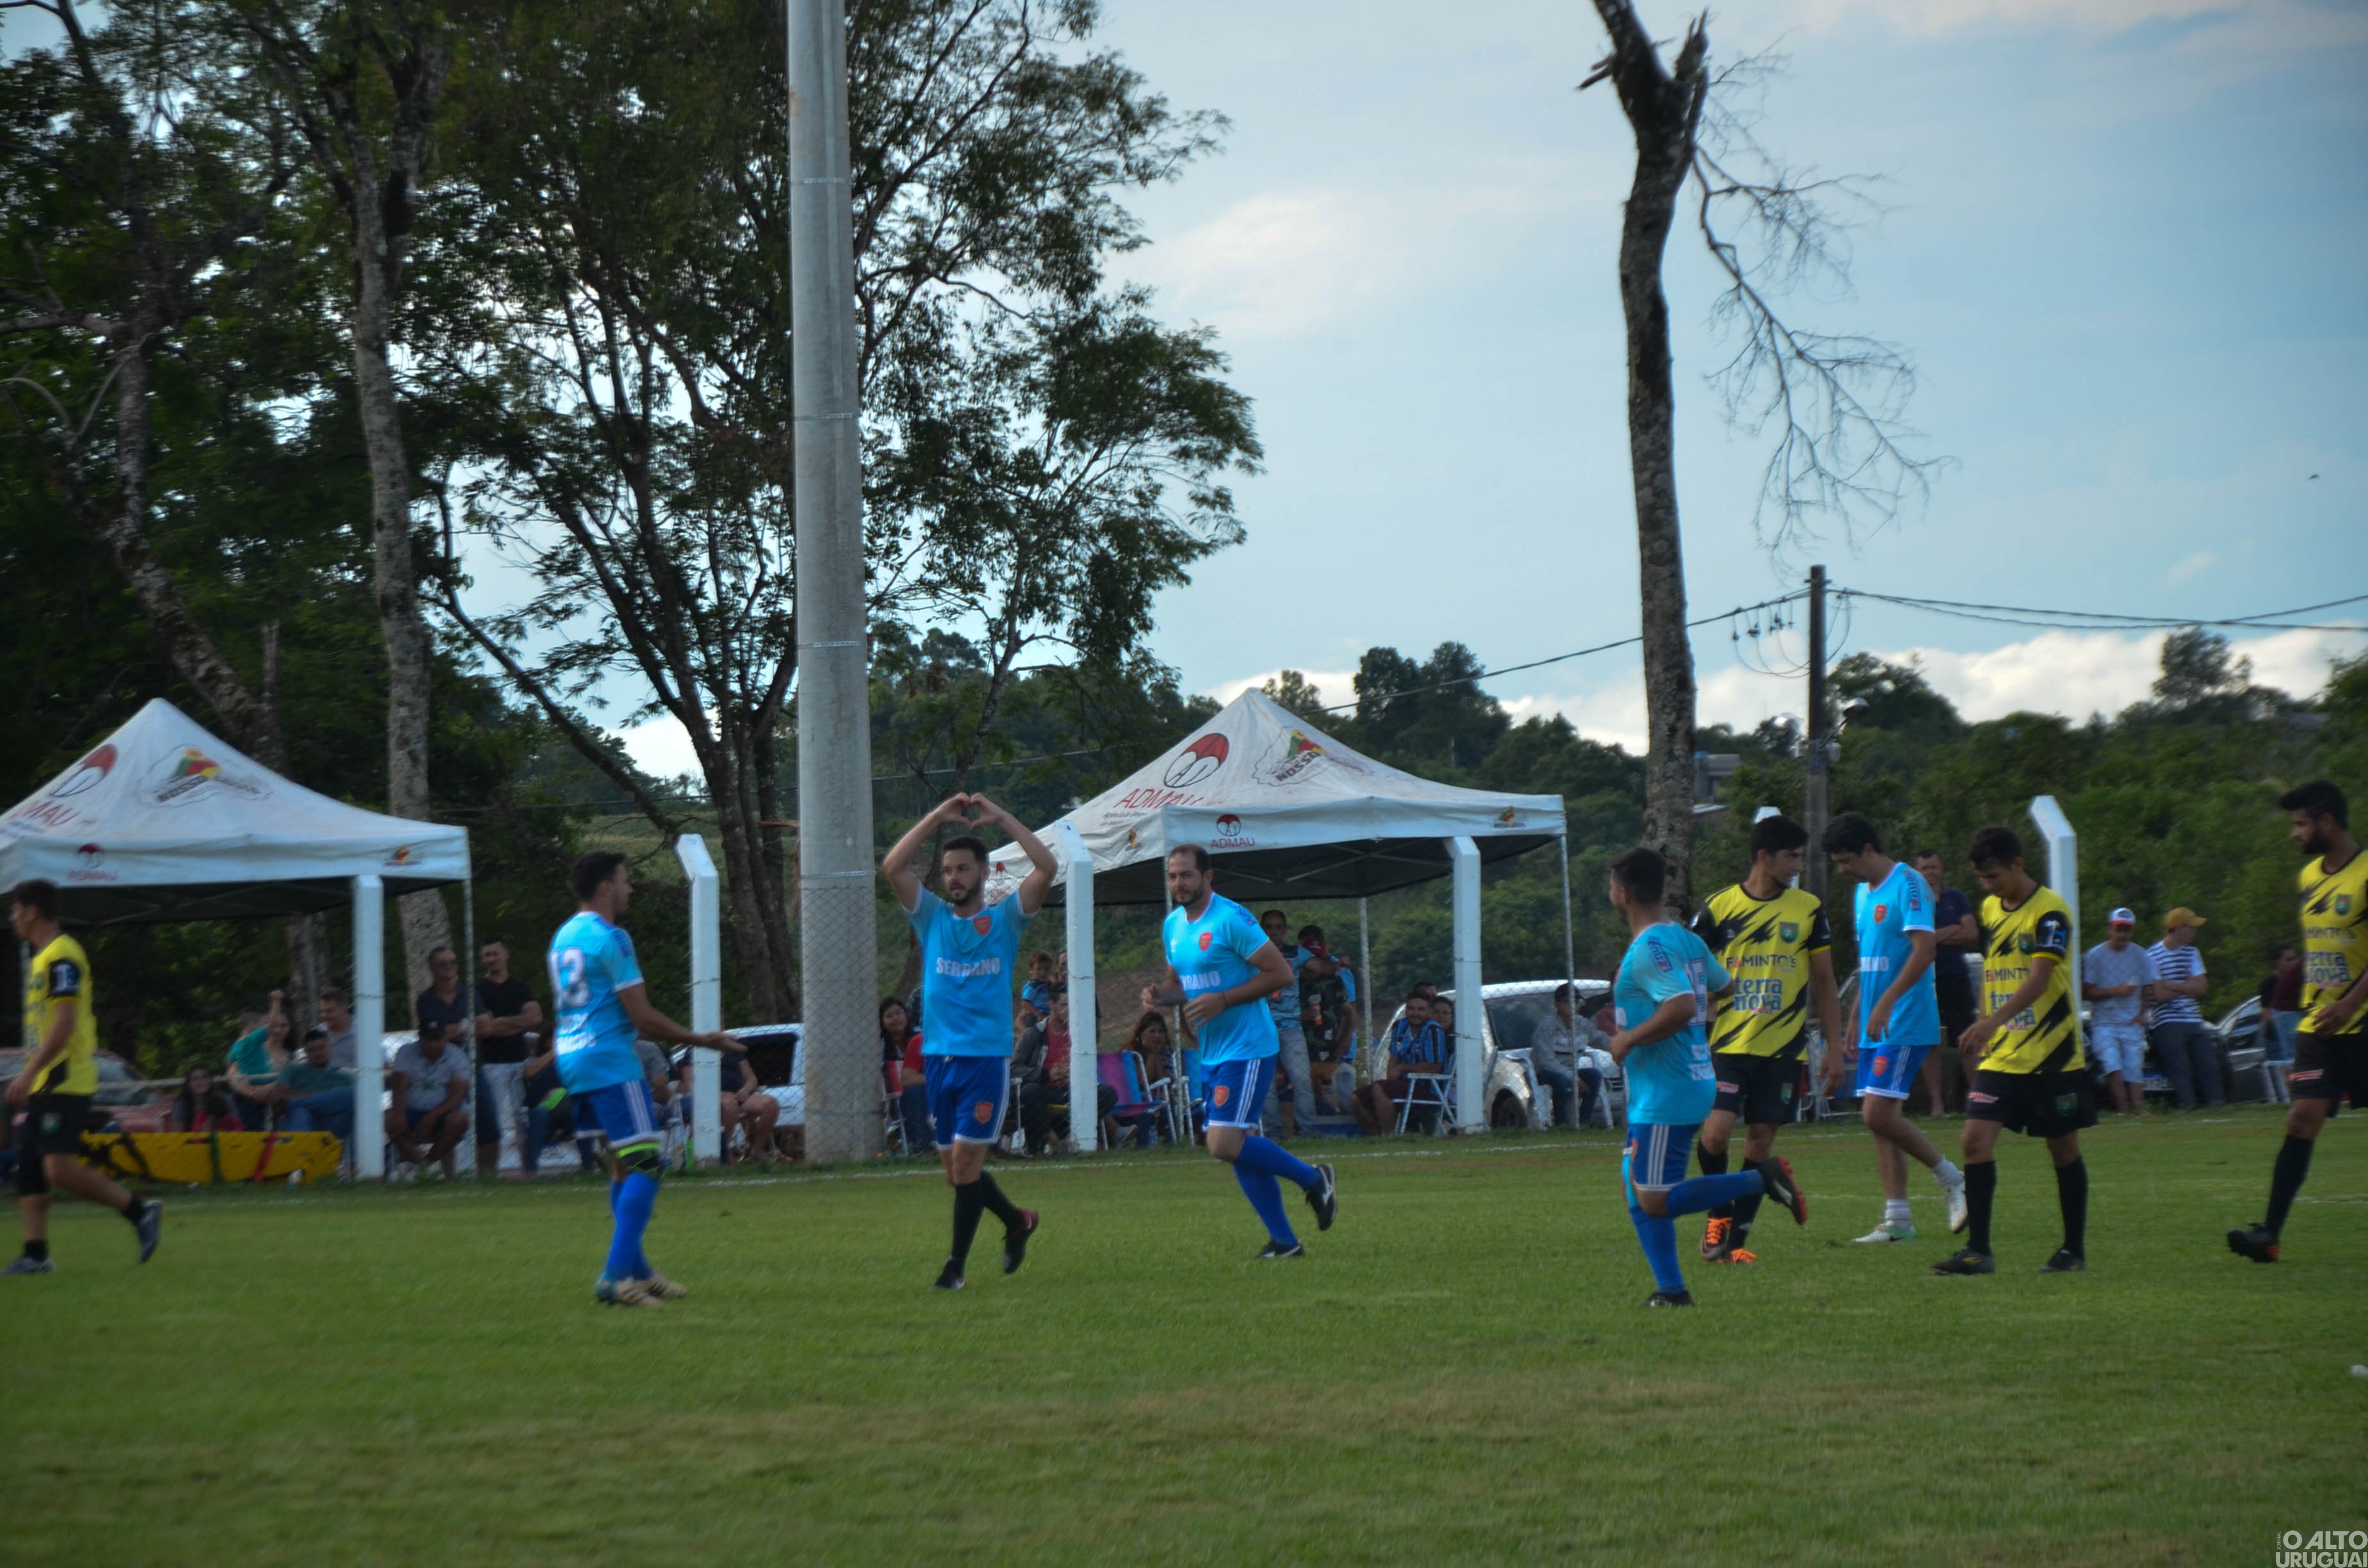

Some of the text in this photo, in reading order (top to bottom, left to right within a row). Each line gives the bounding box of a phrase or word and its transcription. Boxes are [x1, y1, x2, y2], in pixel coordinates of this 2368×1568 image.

[1211, 837, 1256, 849] ADMAU
[1734, 977, 1782, 995] terra
[1734, 995, 1782, 1011] nova
